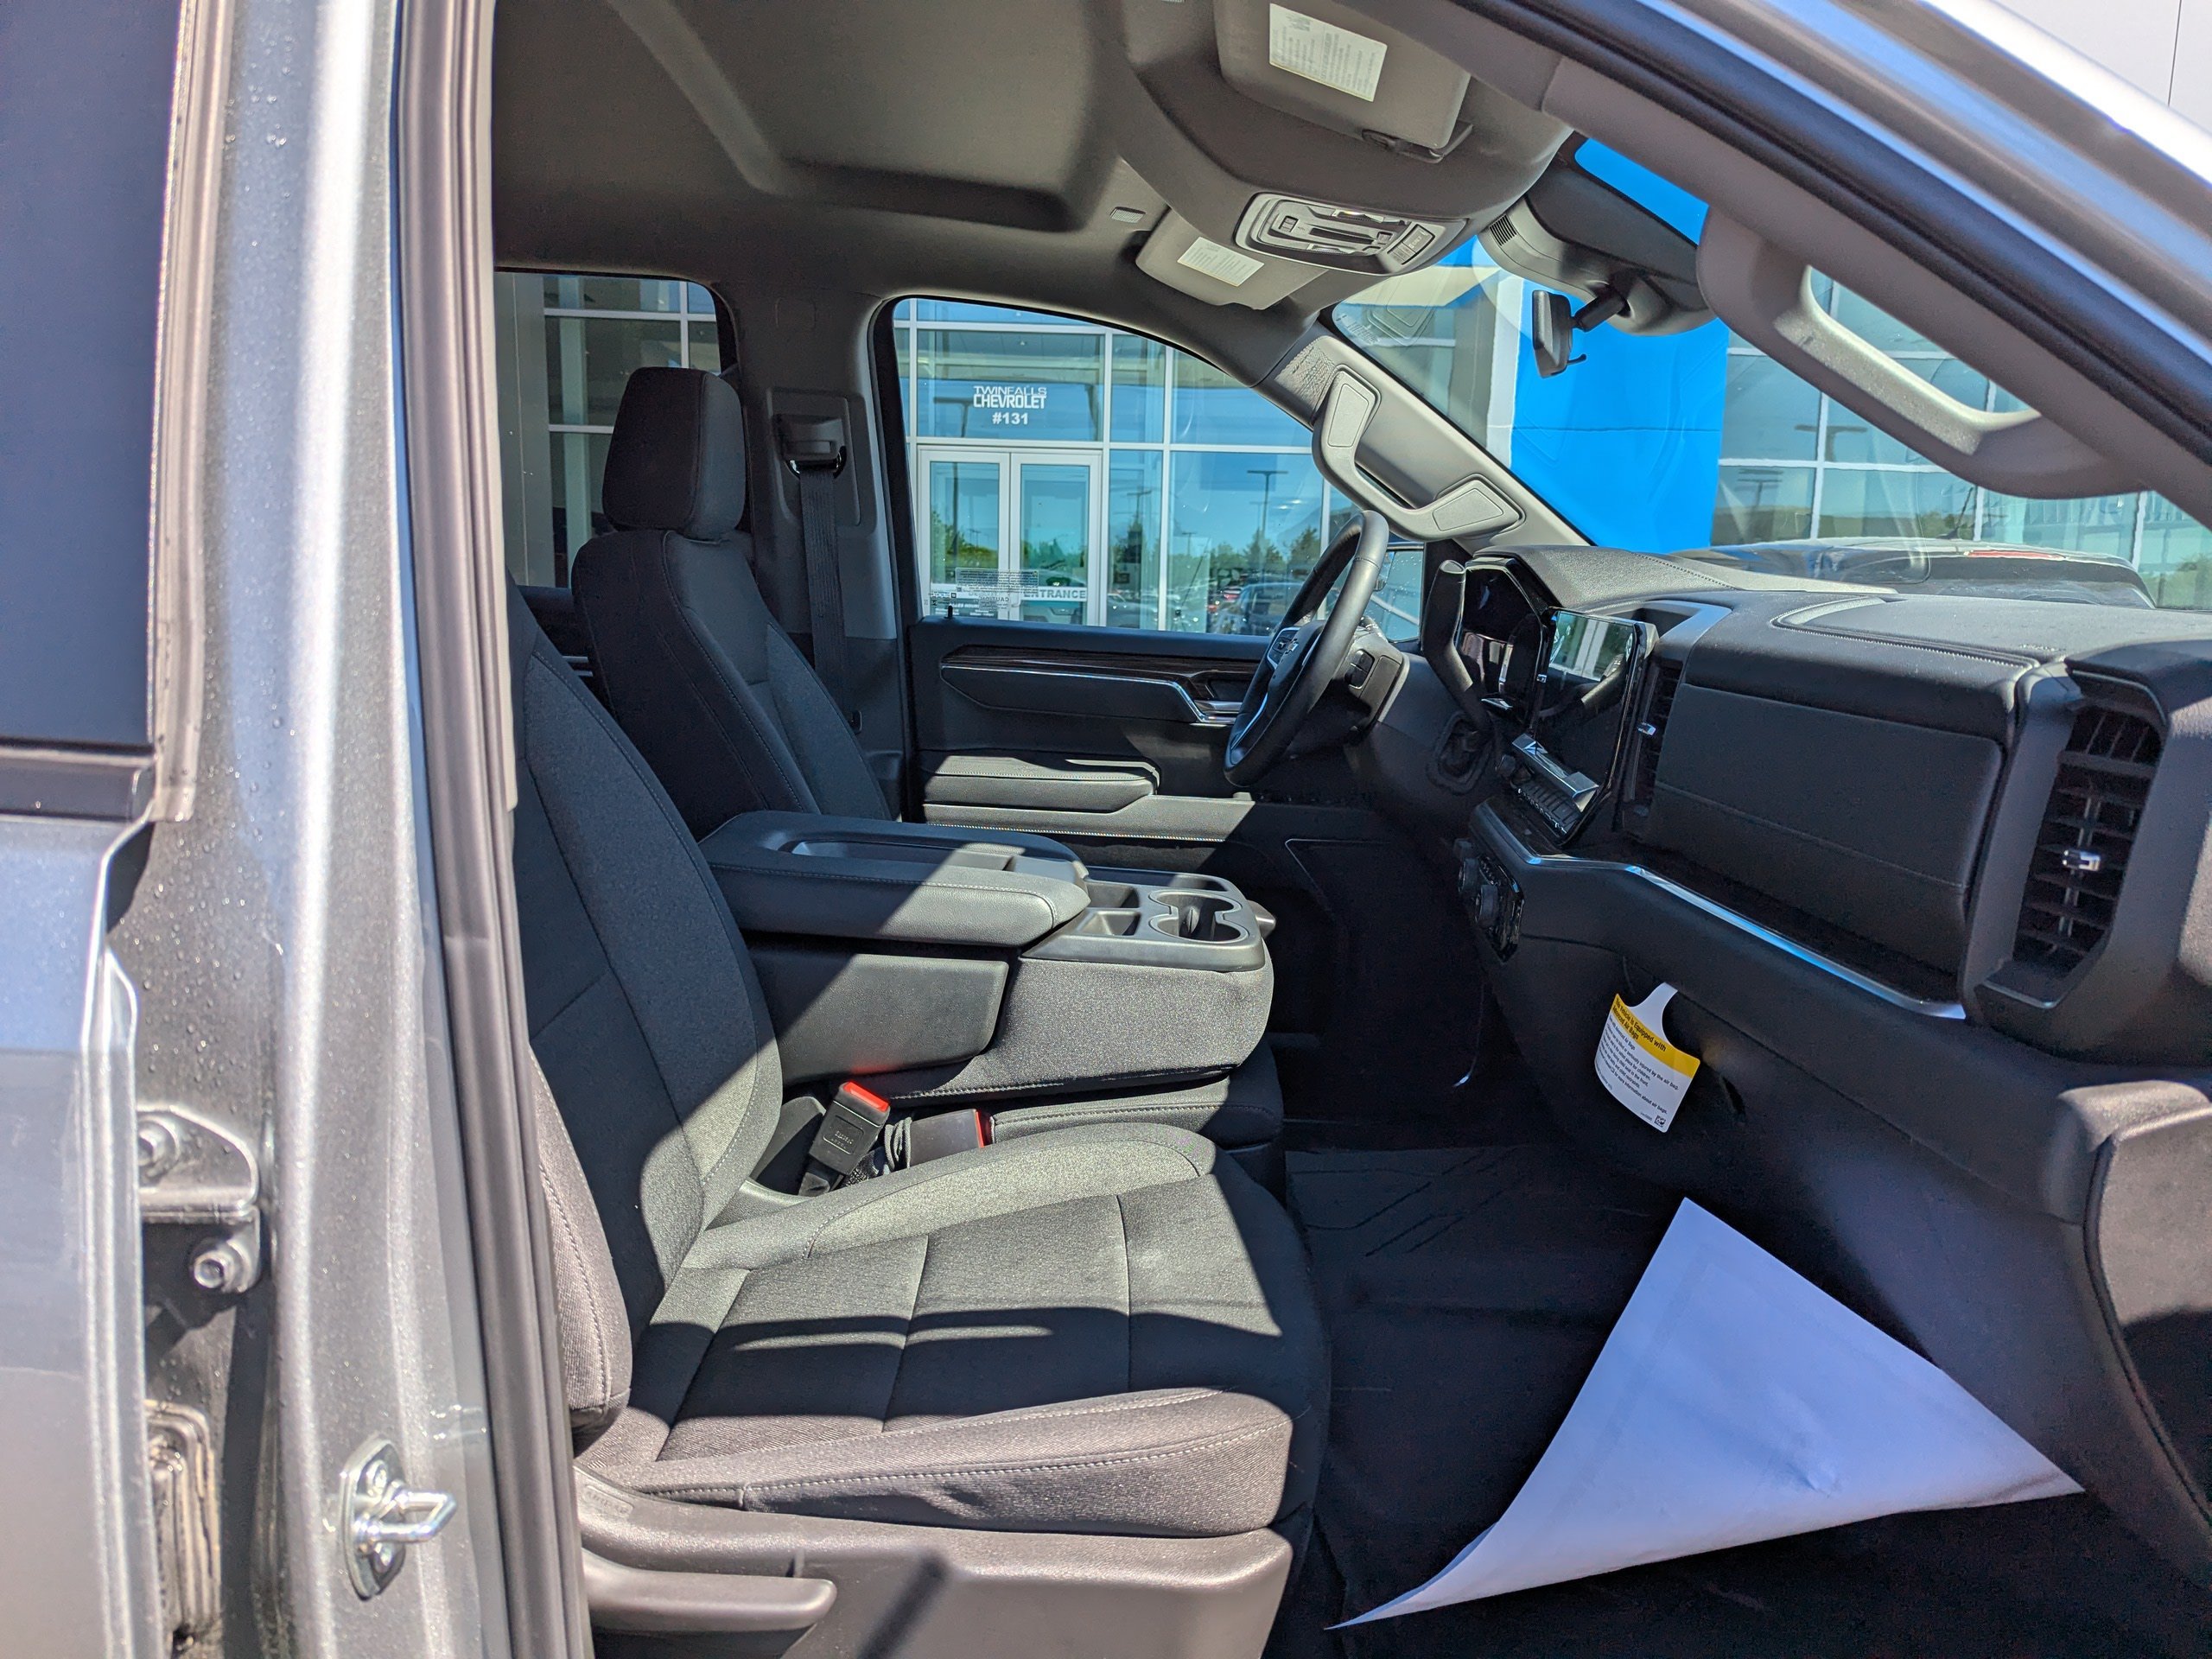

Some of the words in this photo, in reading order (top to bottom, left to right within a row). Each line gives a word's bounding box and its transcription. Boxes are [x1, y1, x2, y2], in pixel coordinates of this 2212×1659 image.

[973, 394, 1046, 409] CHEVROLET
[992, 411, 1028, 425] #131
[1633, 1022, 1655, 1043] Equipped
[1654, 1039, 1667, 1052] with
